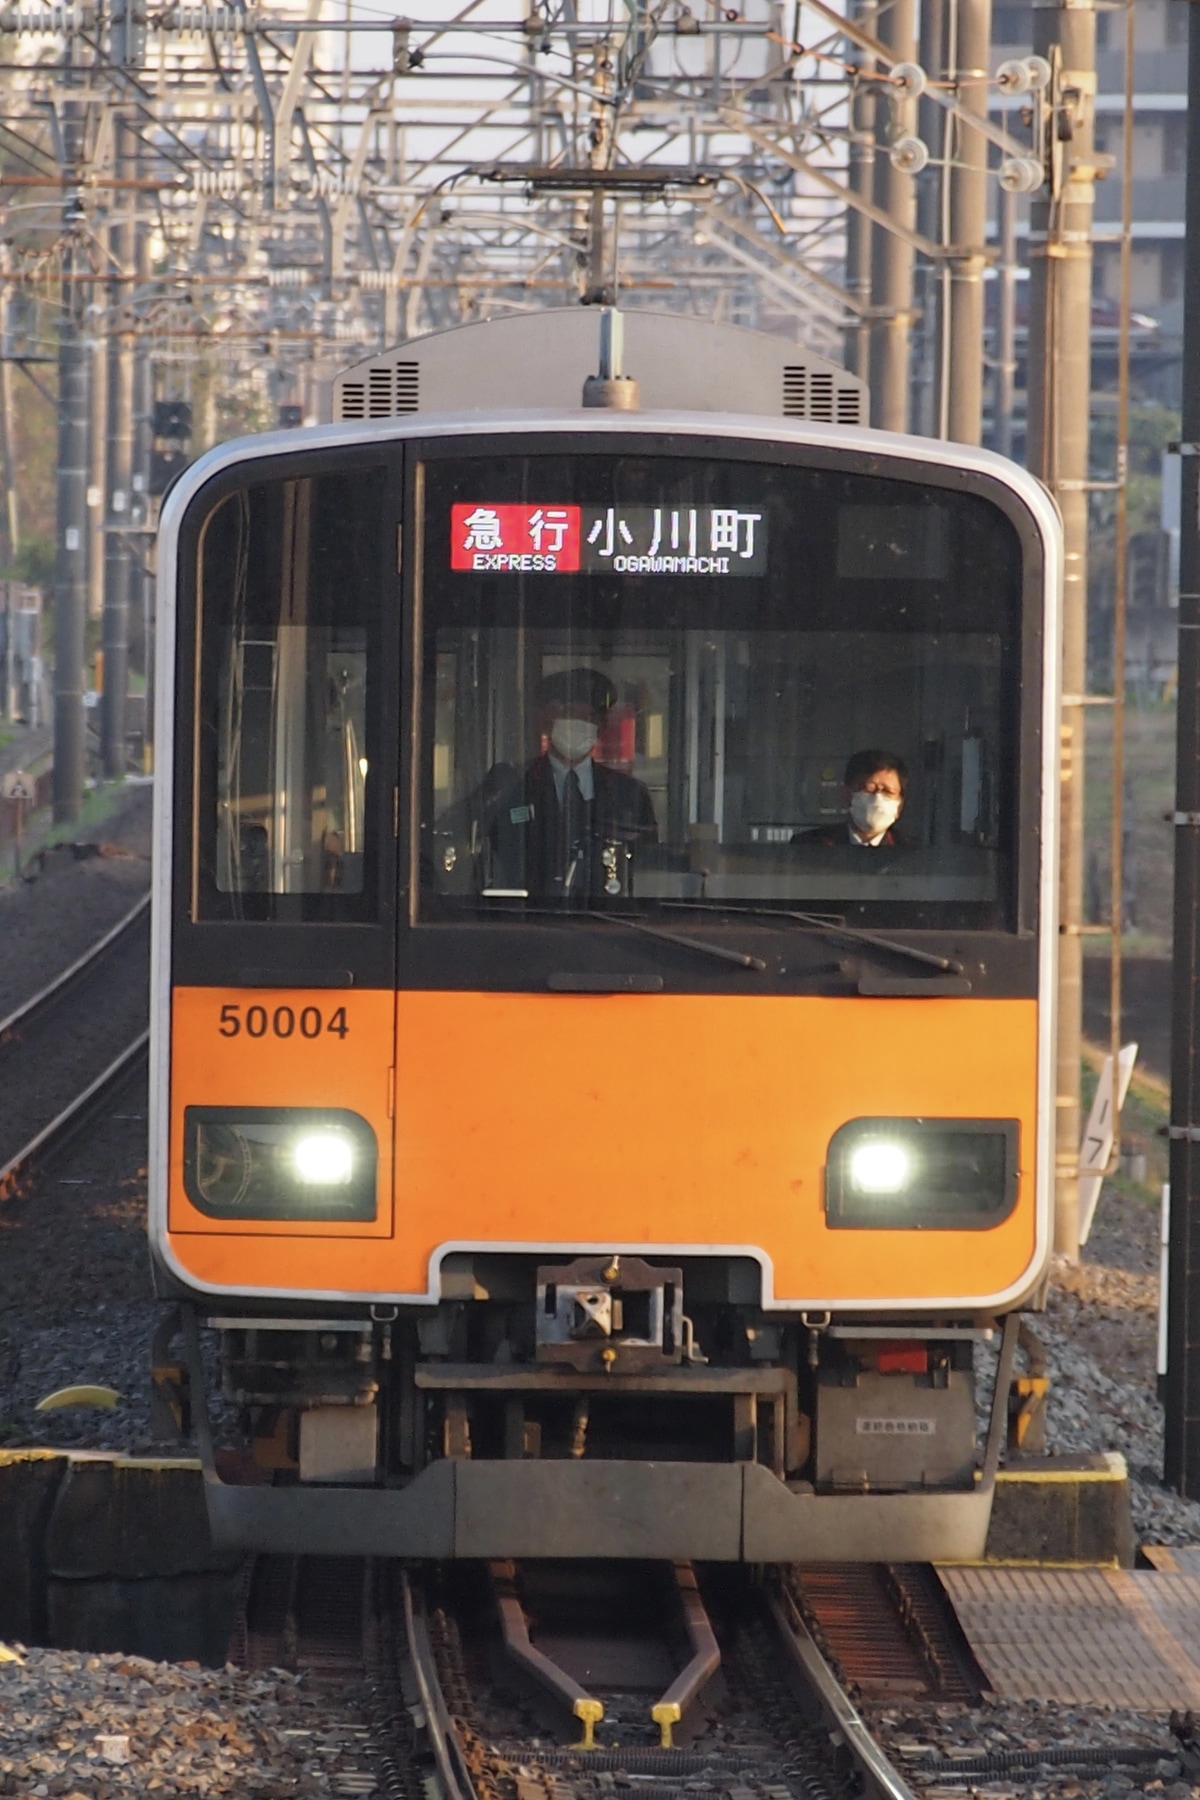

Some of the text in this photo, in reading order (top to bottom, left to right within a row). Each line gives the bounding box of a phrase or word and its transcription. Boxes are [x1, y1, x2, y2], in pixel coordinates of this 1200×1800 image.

[463, 508, 569, 550] 急行
[587, 508, 762, 557] 小川町
[472, 554, 556, 571] EXPRESS
[613, 556, 729, 574] OGAWAMACHI
[218, 1004, 349, 1039] 50004
